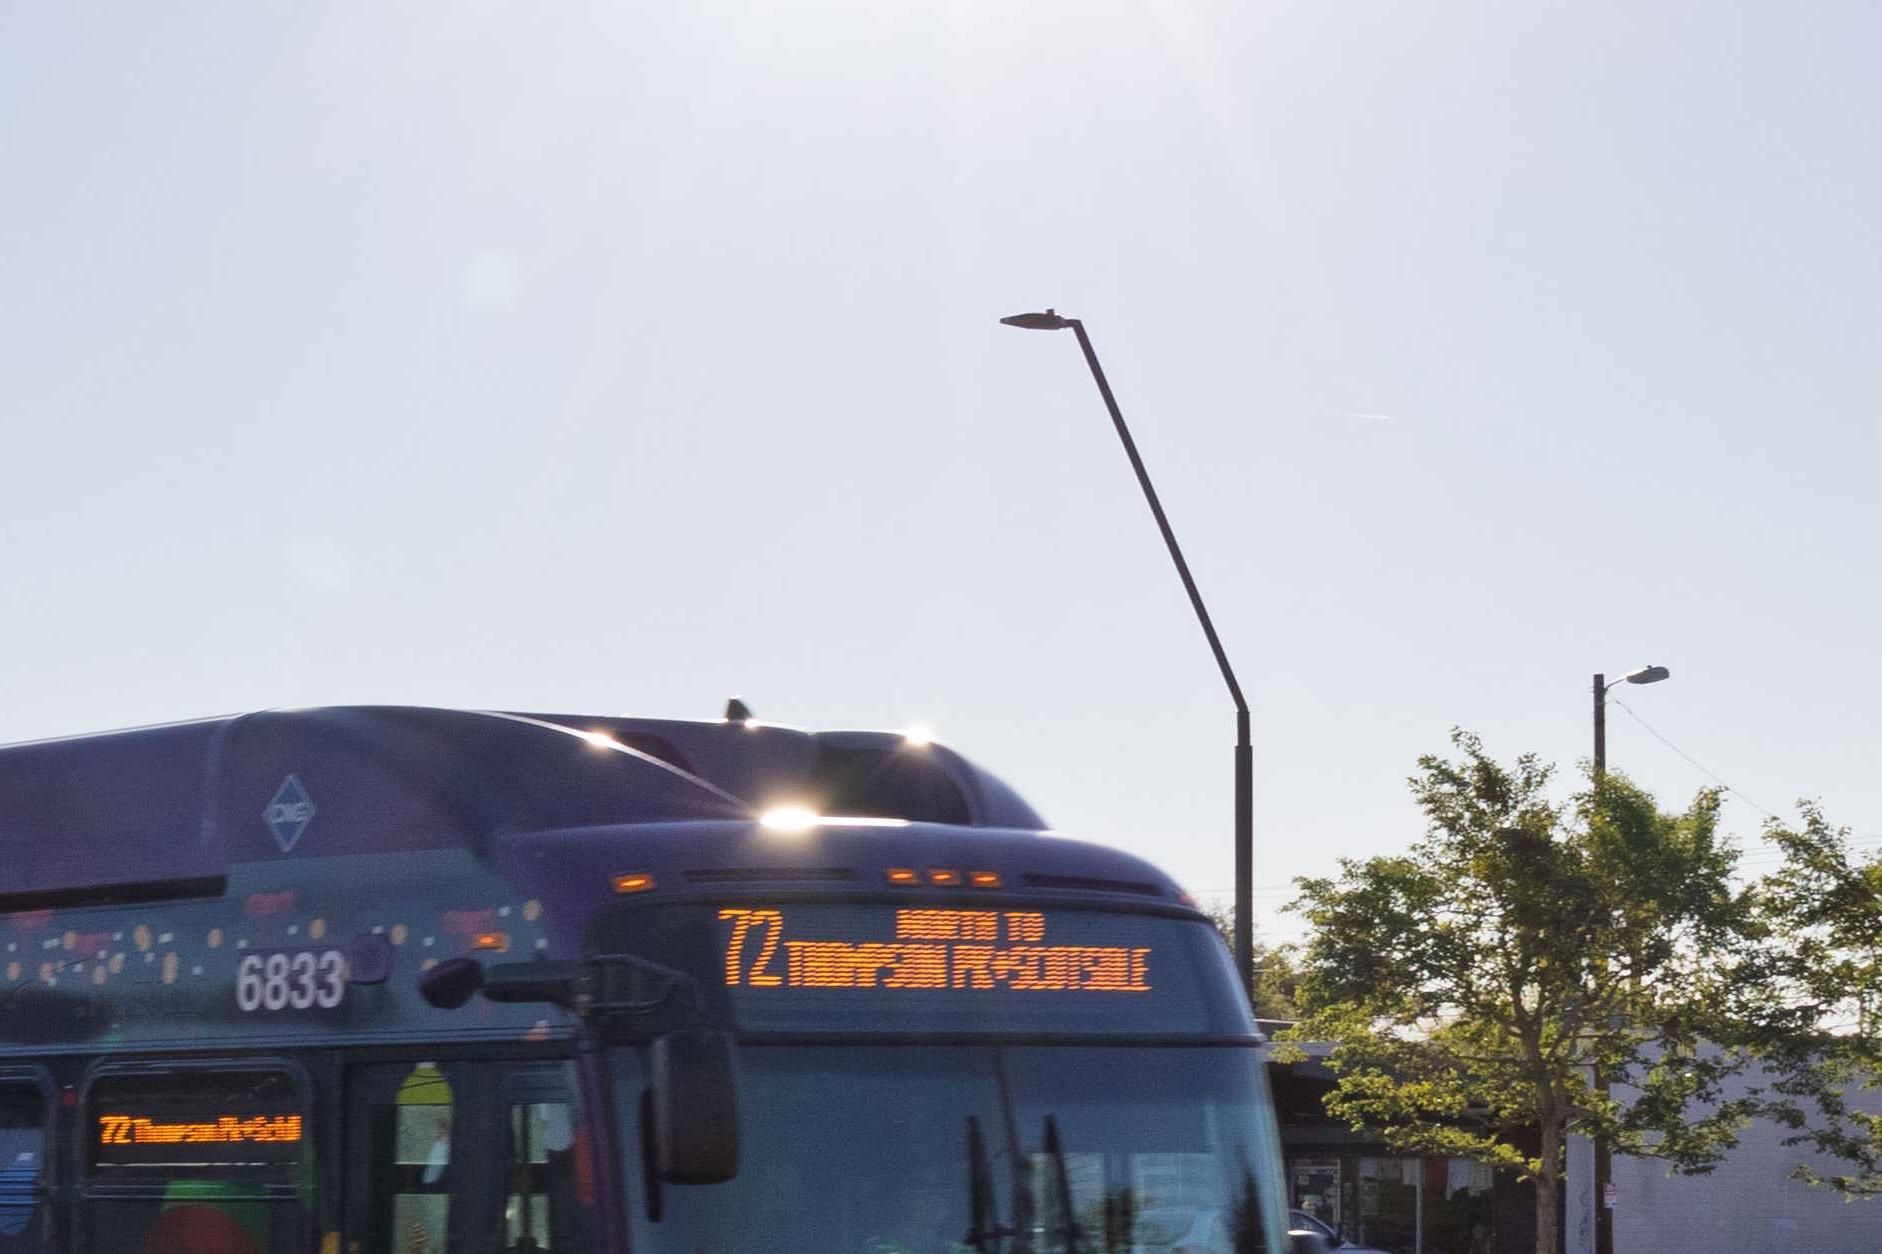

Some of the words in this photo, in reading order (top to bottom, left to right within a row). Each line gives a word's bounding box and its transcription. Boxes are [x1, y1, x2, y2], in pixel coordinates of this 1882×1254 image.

[718, 908, 783, 986] 72
[1003, 911, 1046, 942] TO
[237, 950, 345, 1012] 6833
[99, 1115, 132, 1144] 72
